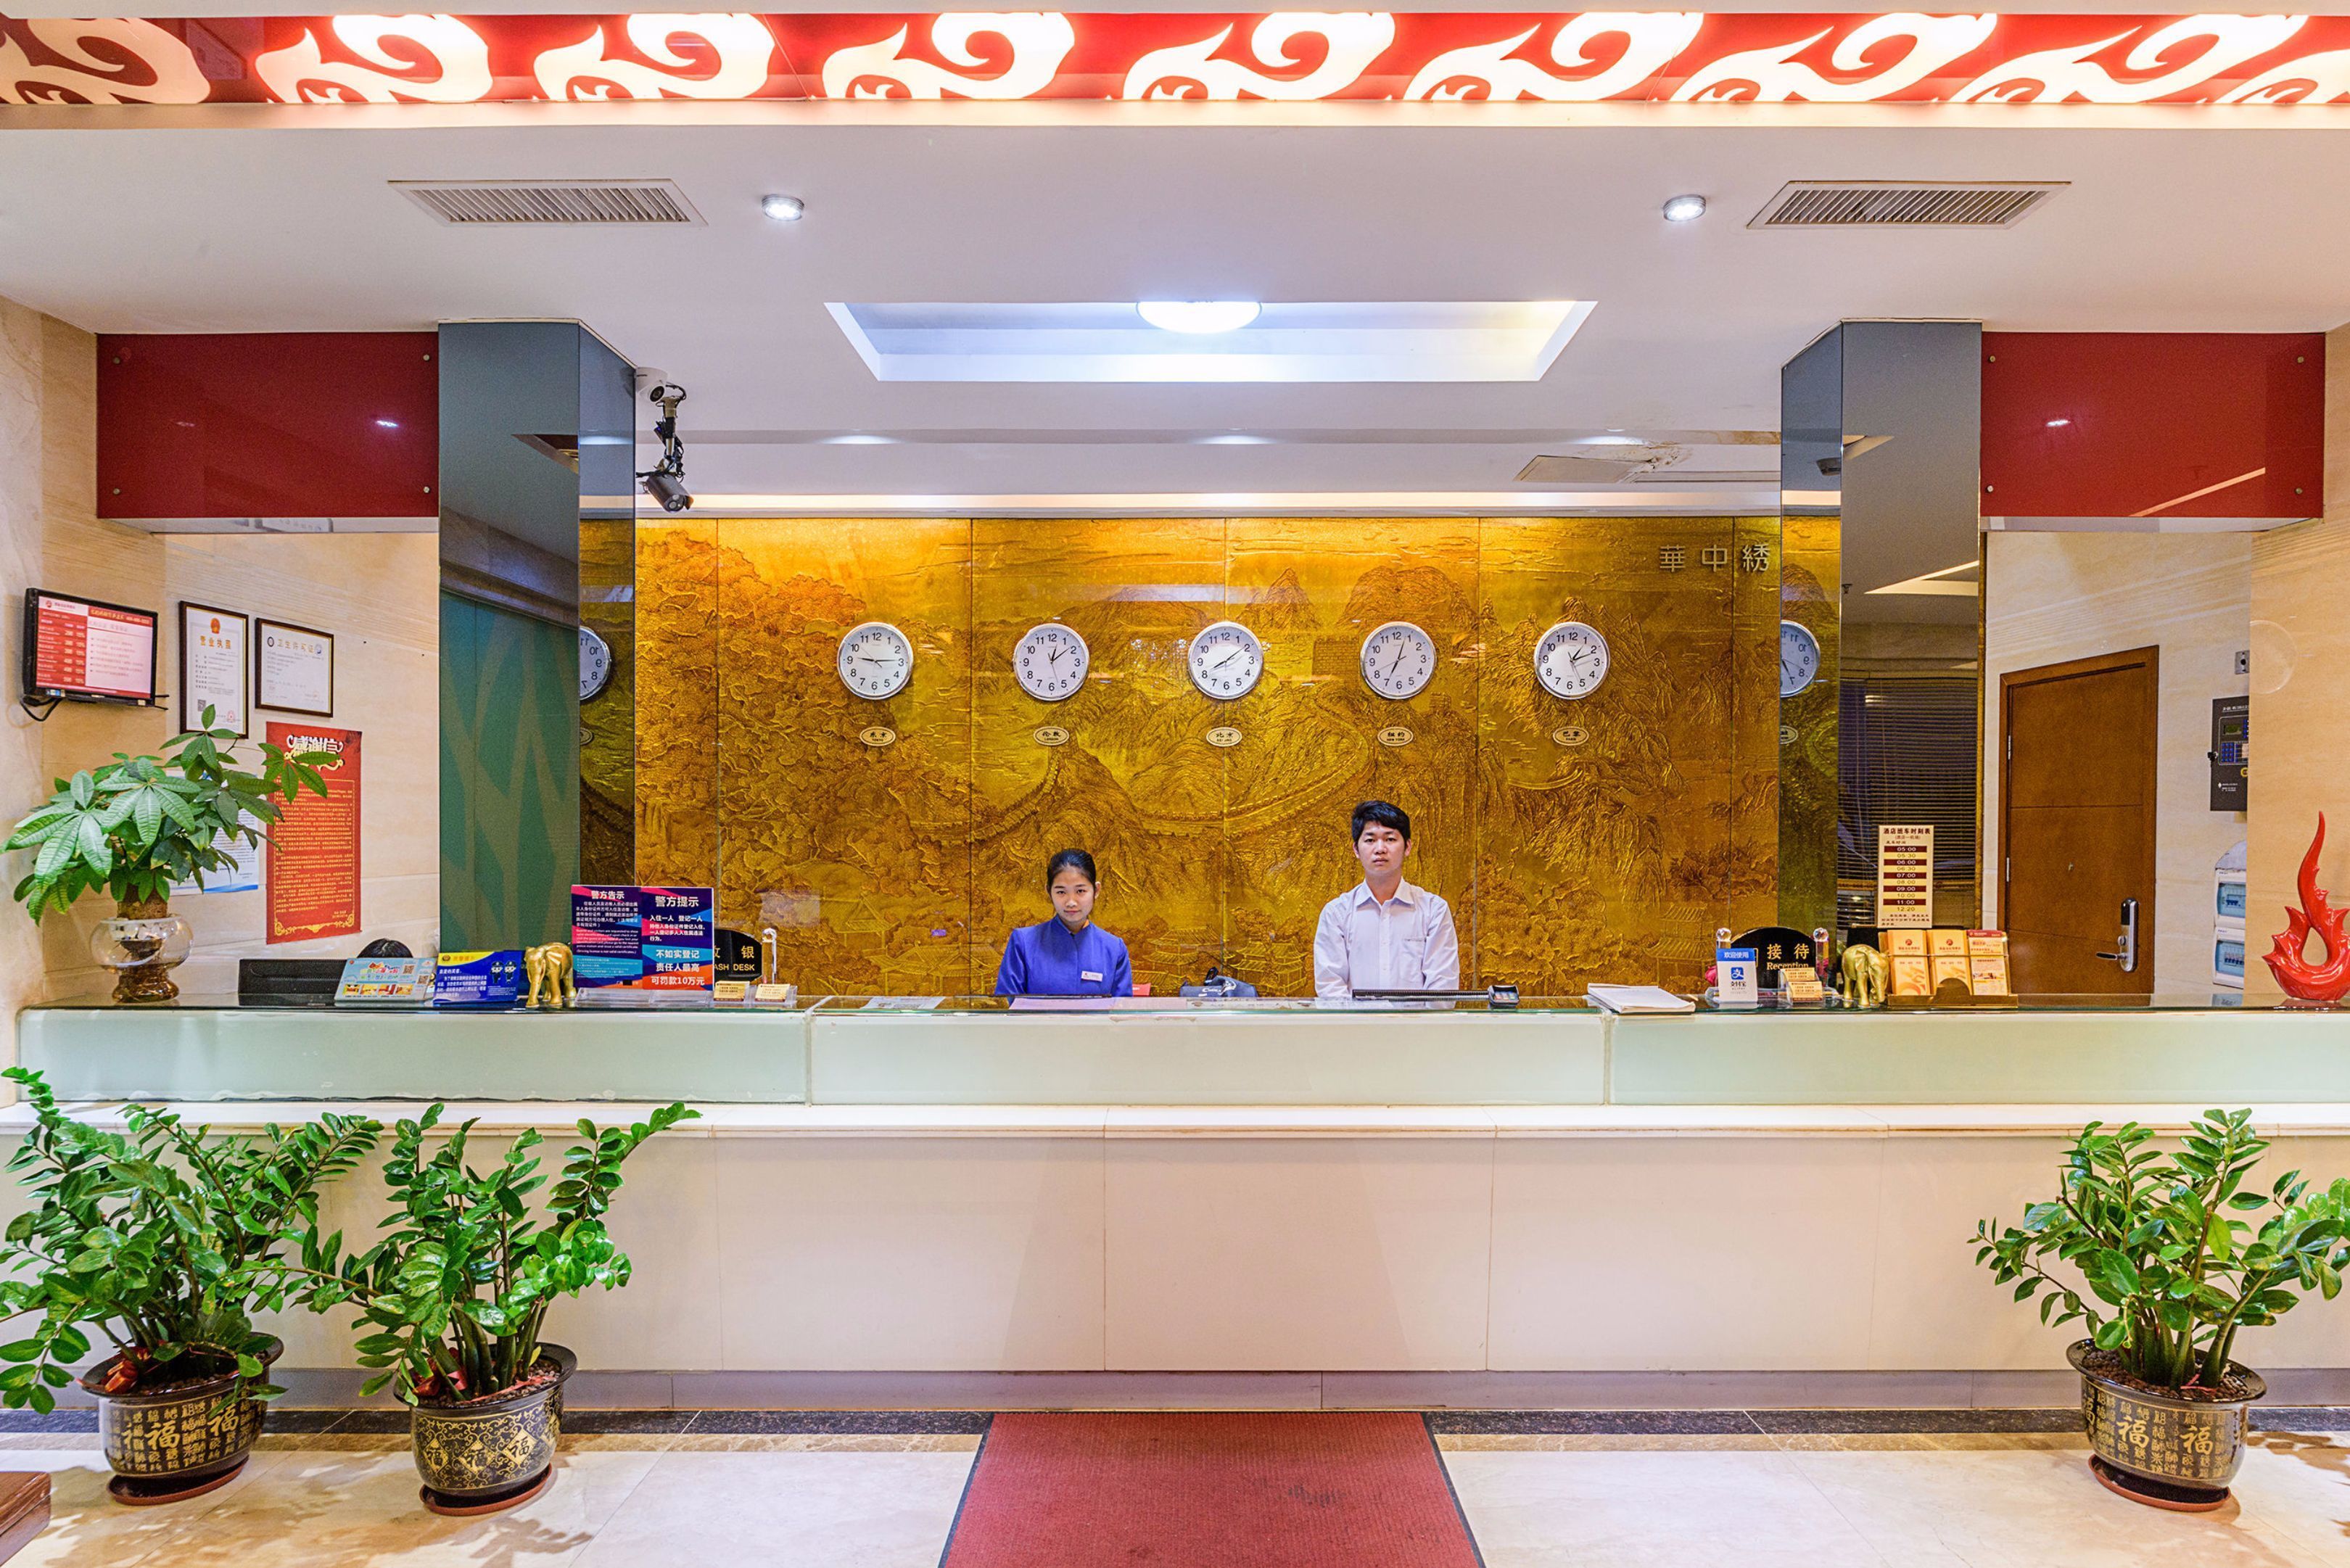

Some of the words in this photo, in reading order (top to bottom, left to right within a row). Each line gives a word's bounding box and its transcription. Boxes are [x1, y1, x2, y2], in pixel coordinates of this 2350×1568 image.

[277, 638, 313, 653] 卫生许可证
[1027, 645, 1035, 654] 10
[1023, 658, 1029, 667] 9
[1369, 658, 1375, 667] 9
[1594, 658, 1600, 667] 3
[592, 891, 624, 899] 警方告示
[655, 896, 699, 907] 警方提示
[656, 949, 699, 959] 不如实登记
[1767, 944, 1809, 960] 接待
[656, 963, 699, 972] 责任人最高
[651, 976, 705, 986] 可罚款10万元
[145, 1420, 181, 1451] 福
[2116, 1416, 2149, 1448] 福
[2180, 1426, 2212, 1455] 福
[509, 1436, 529, 1458] 福
